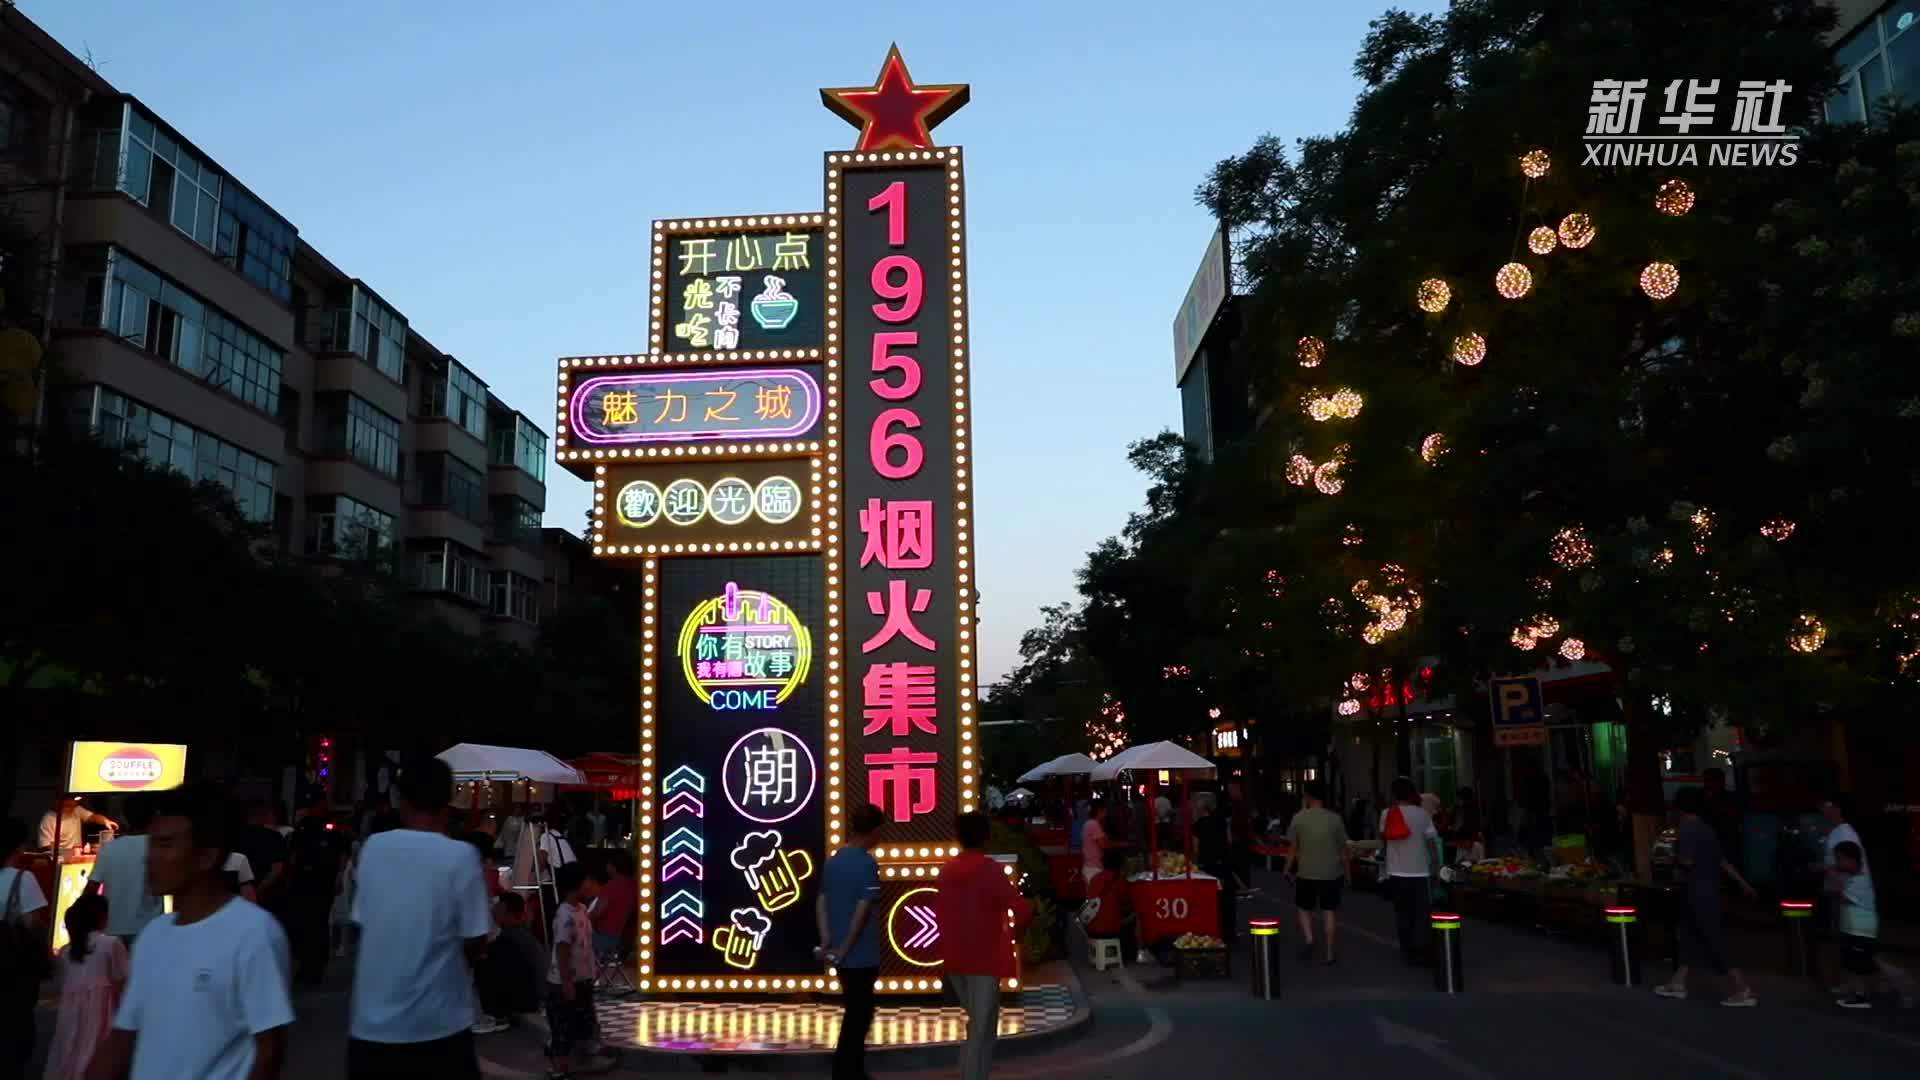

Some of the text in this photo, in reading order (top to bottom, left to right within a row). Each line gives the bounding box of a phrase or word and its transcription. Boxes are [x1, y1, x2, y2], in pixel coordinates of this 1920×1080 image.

[678, 231, 811, 276] 开心点
[675, 278, 714, 347] 光吃
[601, 383, 792, 426] 魅力之城
[623, 484, 793, 519] 歡迎光臨
[860, 181, 936, 822] 1956烟火集市
[695, 633, 744, 661] 你有
[745, 635, 792, 649] STORY
[744, 650, 793, 678] 故事
[710, 689, 778, 711] COME
[1499, 683, 1529, 720] P
[741, 743, 798, 807] 潮
[1155, 896, 1190, 920] 30
